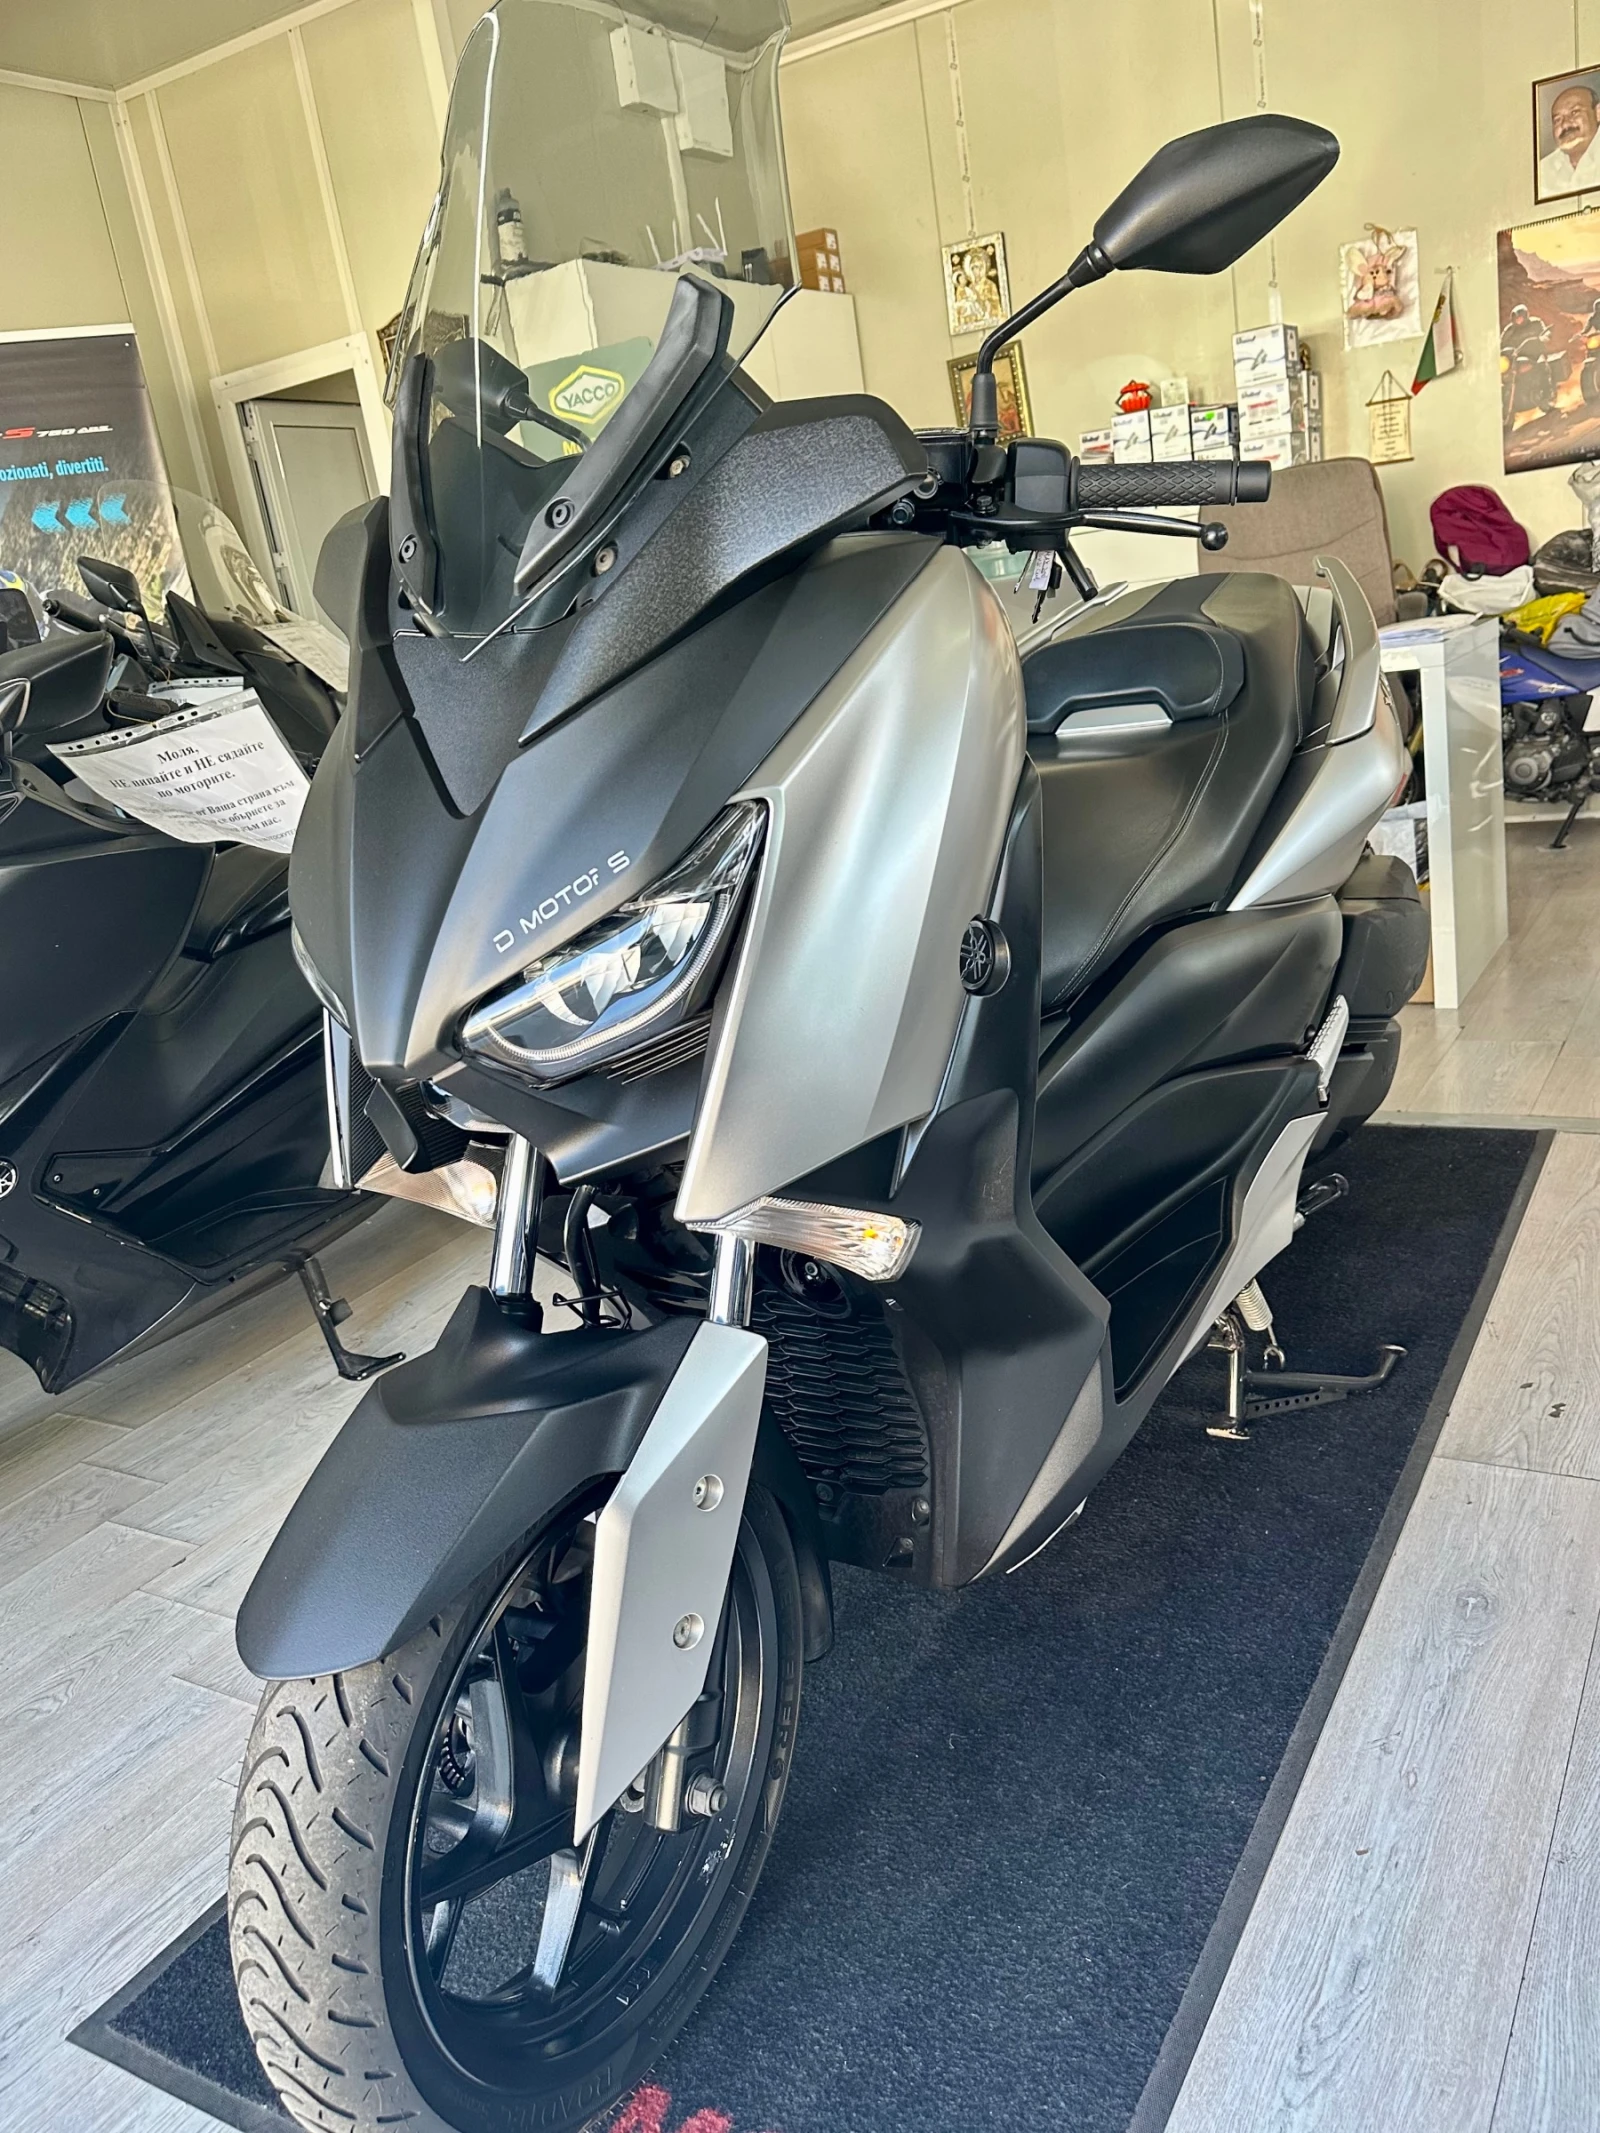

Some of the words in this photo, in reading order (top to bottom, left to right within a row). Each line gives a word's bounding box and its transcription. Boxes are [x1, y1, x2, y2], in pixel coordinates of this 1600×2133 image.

[562, 382, 615, 409] YACCO
[55, 456, 110, 477] divertiti.
[109, 778, 131, 789] НЕ
[131, 768, 183, 788] пипайте
[183, 765, 193, 775] и
[193, 755, 217, 772] НЕ
[217, 741, 265, 764] сядайте
[156, 745, 200, 765] Моля,
[157, 788, 173, 799] по
[174, 770, 236, 797] моторите.
[206, 801, 237, 816] Ваша
[236, 789, 273, 807] страна
[272, 780, 296, 794] към
[274, 798, 287, 809] за
[260, 816, 282, 829] нас.
[493, 929, 515, 953] D
